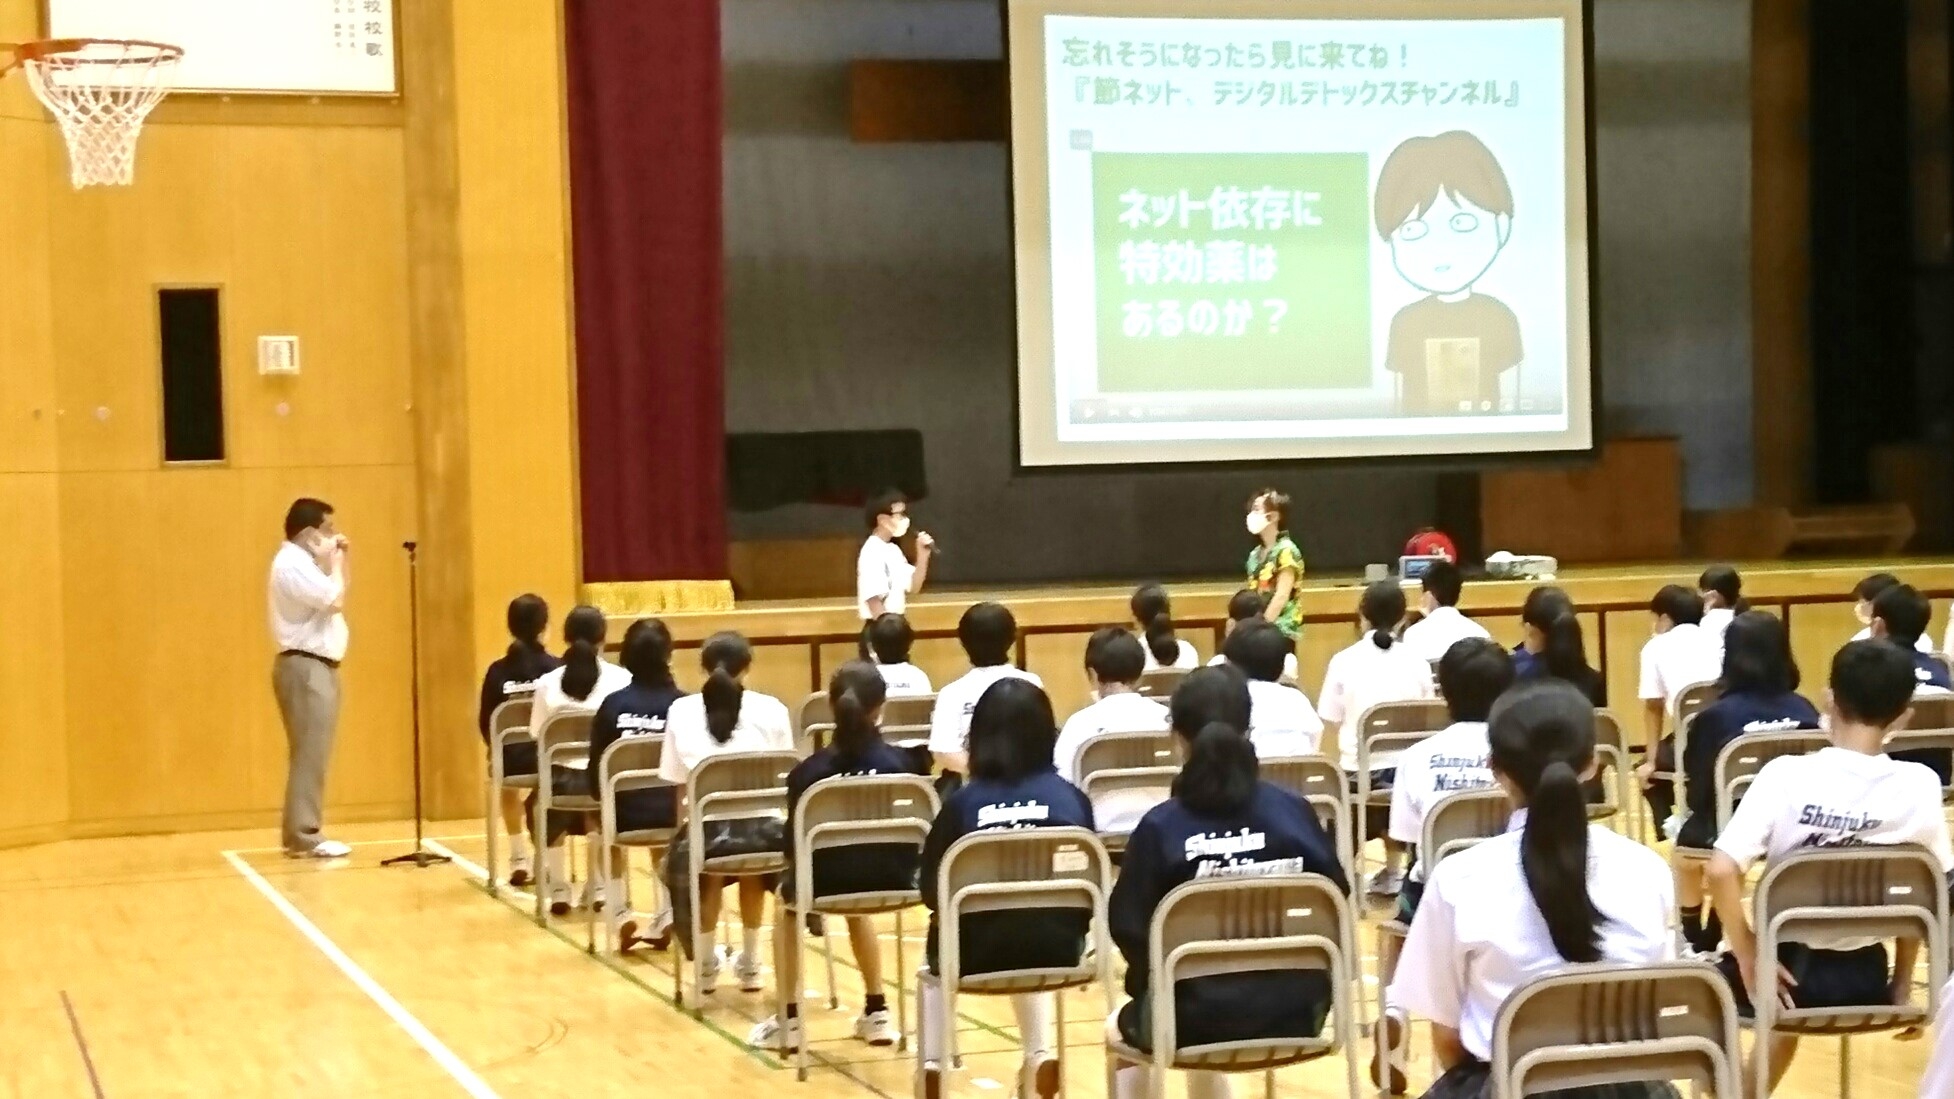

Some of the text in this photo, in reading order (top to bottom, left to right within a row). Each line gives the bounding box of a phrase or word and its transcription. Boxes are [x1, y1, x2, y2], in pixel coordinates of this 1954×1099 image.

[1118, 184, 1323, 231] ネット依存に
[1118, 239, 1278, 285] 特効薬は
[1122, 298, 1289, 337] あるのか？
